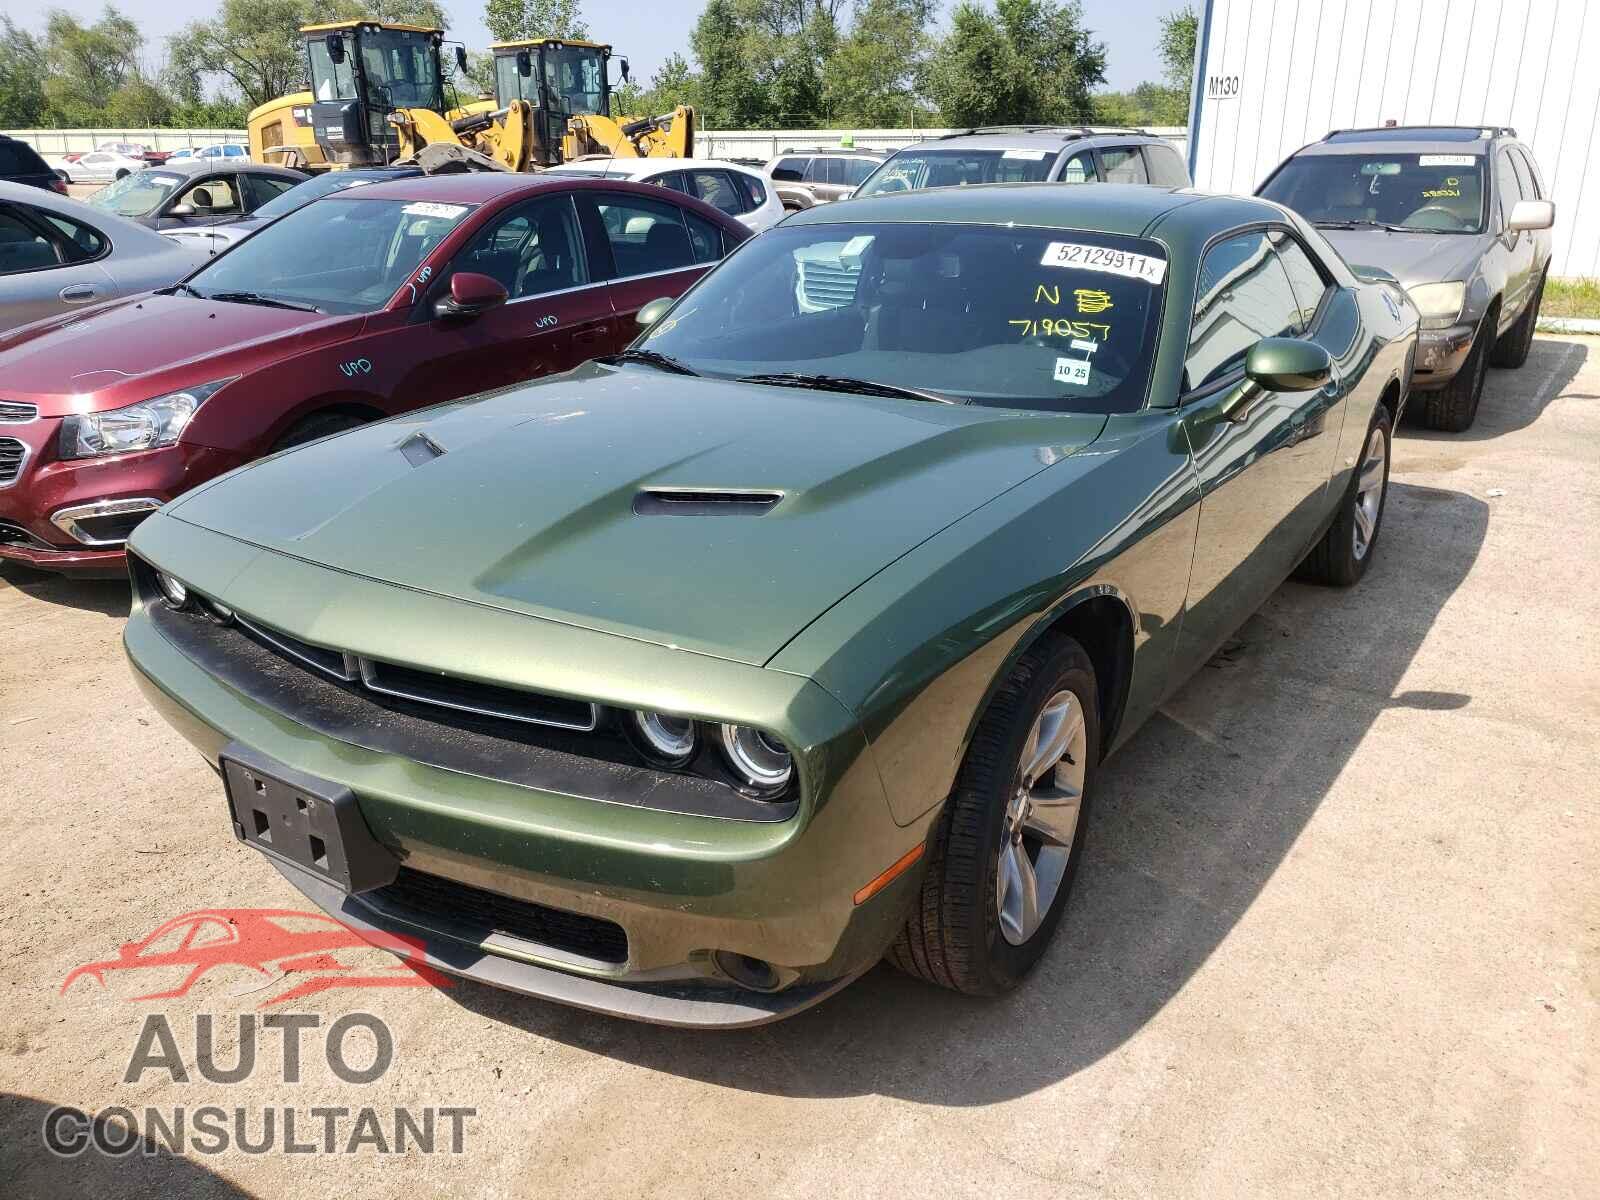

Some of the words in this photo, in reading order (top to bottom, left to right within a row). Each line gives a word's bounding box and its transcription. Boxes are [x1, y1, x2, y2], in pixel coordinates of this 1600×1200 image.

[1209, 76, 1239, 96] M130
[1034, 284, 1060, 305] N
[1008, 318, 1111, 341] 719057
[339, 358, 372, 377] UPD
[1058, 366, 1070, 375] 10
[1074, 369, 1086, 378] 25
